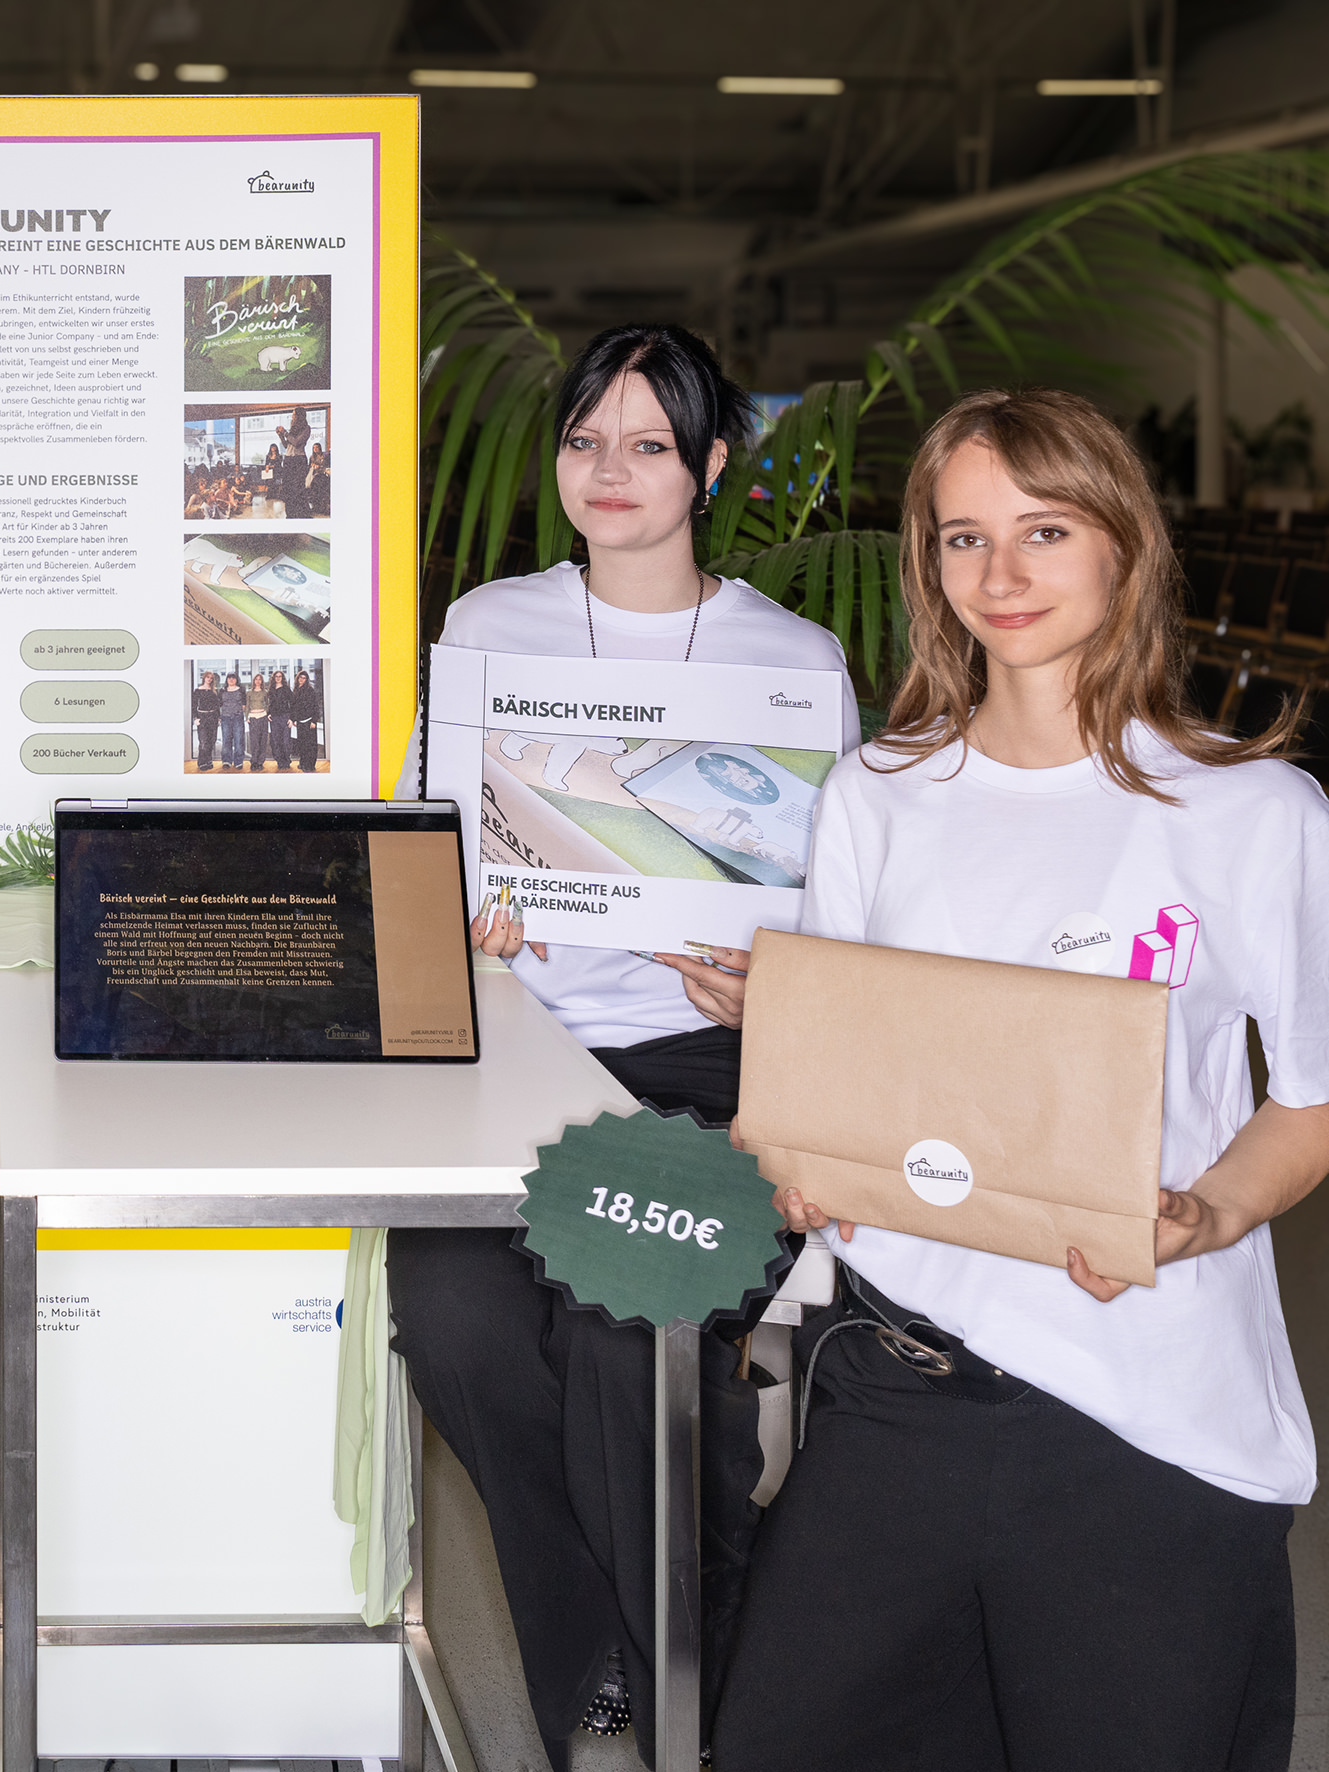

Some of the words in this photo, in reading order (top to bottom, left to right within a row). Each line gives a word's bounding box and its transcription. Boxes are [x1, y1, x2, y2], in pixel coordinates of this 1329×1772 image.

[258, 178, 315, 193] bearunity
[48, 240, 81, 251] EINE
[86, 240, 181, 251] GESCHICHTE
[185, 239, 215, 251] AUS
[220, 239, 250, 250] DEM
[256, 235, 346, 250] BÄRENWALD
[33, 265, 56, 275] HTL
[61, 265, 125, 275] DORNBIRN
[13, 293, 73, 303] Ethikunterricht
[75, 293, 112, 303] entstand,
[115, 293, 140, 302] wurde
[23, 306, 36, 315] Mit
[38, 306, 56, 315] dem
[58, 306, 76, 316] Ziel,
[79, 306, 111, 315] Kindern
[113, 306, 151, 317] frühzeitig
[205, 294, 304, 339] Bärisch
[238, 315, 299, 333] vereint
[18, 475, 47, 486] UND
[52, 475, 138, 486] ERGEBNISSE
[34, 497, 78, 508] gedrucktes
[80, 496, 127, 506] Kinderbuch
[21, 509, 52, 520] Respekt
[55, 509, 70, 519] und
[72, 509, 127, 519] Gemeinschaft
[34, 645, 46, 654] ab
[47, 645, 54, 654] 3
[56, 645, 85, 657] jahren
[87, 645, 125, 657] geeignet
[53, 697, 60, 707] 6
[63, 697, 105, 709] Lesungen
[492, 694, 579, 719] BÄRISCH
[581, 702, 667, 723] VEREINT
[775, 697, 813, 709] bearunity
[33, 748, 51, 758] 200
[54, 748, 85, 758] Bücher
[88, 748, 127, 758] Verkauft
[487, 874, 518, 889] EINE
[521, 878, 608, 896] GESCHICHTE
[611, 885, 641, 899] AUS
[100, 893, 132, 903] Bärisch
[135, 894, 167, 903] vereint
[180, 895, 199, 903] eine
[201, 894, 249, 904] Geschichte
[270, 894, 287, 904] dem
[290, 894, 337, 904] Bärenwald
[520, 894, 609, 915] BÄRENWALD
[105, 911, 118, 920] Als
[120, 912, 168, 921] Eisbärmama
[171, 912, 186, 921] Elsa
[189, 913, 202, 921] mit
[205, 912, 226, 921] ihren
[228, 912, 260, 921] Kindern
[262, 912, 276, 922] Ella
[278, 912, 294, 922] und
[296, 913, 314, 922] Emil
[316, 913, 332, 922] ihre
[1059, 930, 1112, 951] bearunity
[917, 1164, 969, 1182] bearunity
[585, 1186, 725, 1250] 18,50€
[295, 1297, 332, 1307] austria
[51, 1307, 101, 1318] Mobilität
[272, 1310, 332, 1320] wirtschafts
[36, 1321, 80, 1331] struktur
[293, 1322, 332, 1333] service
